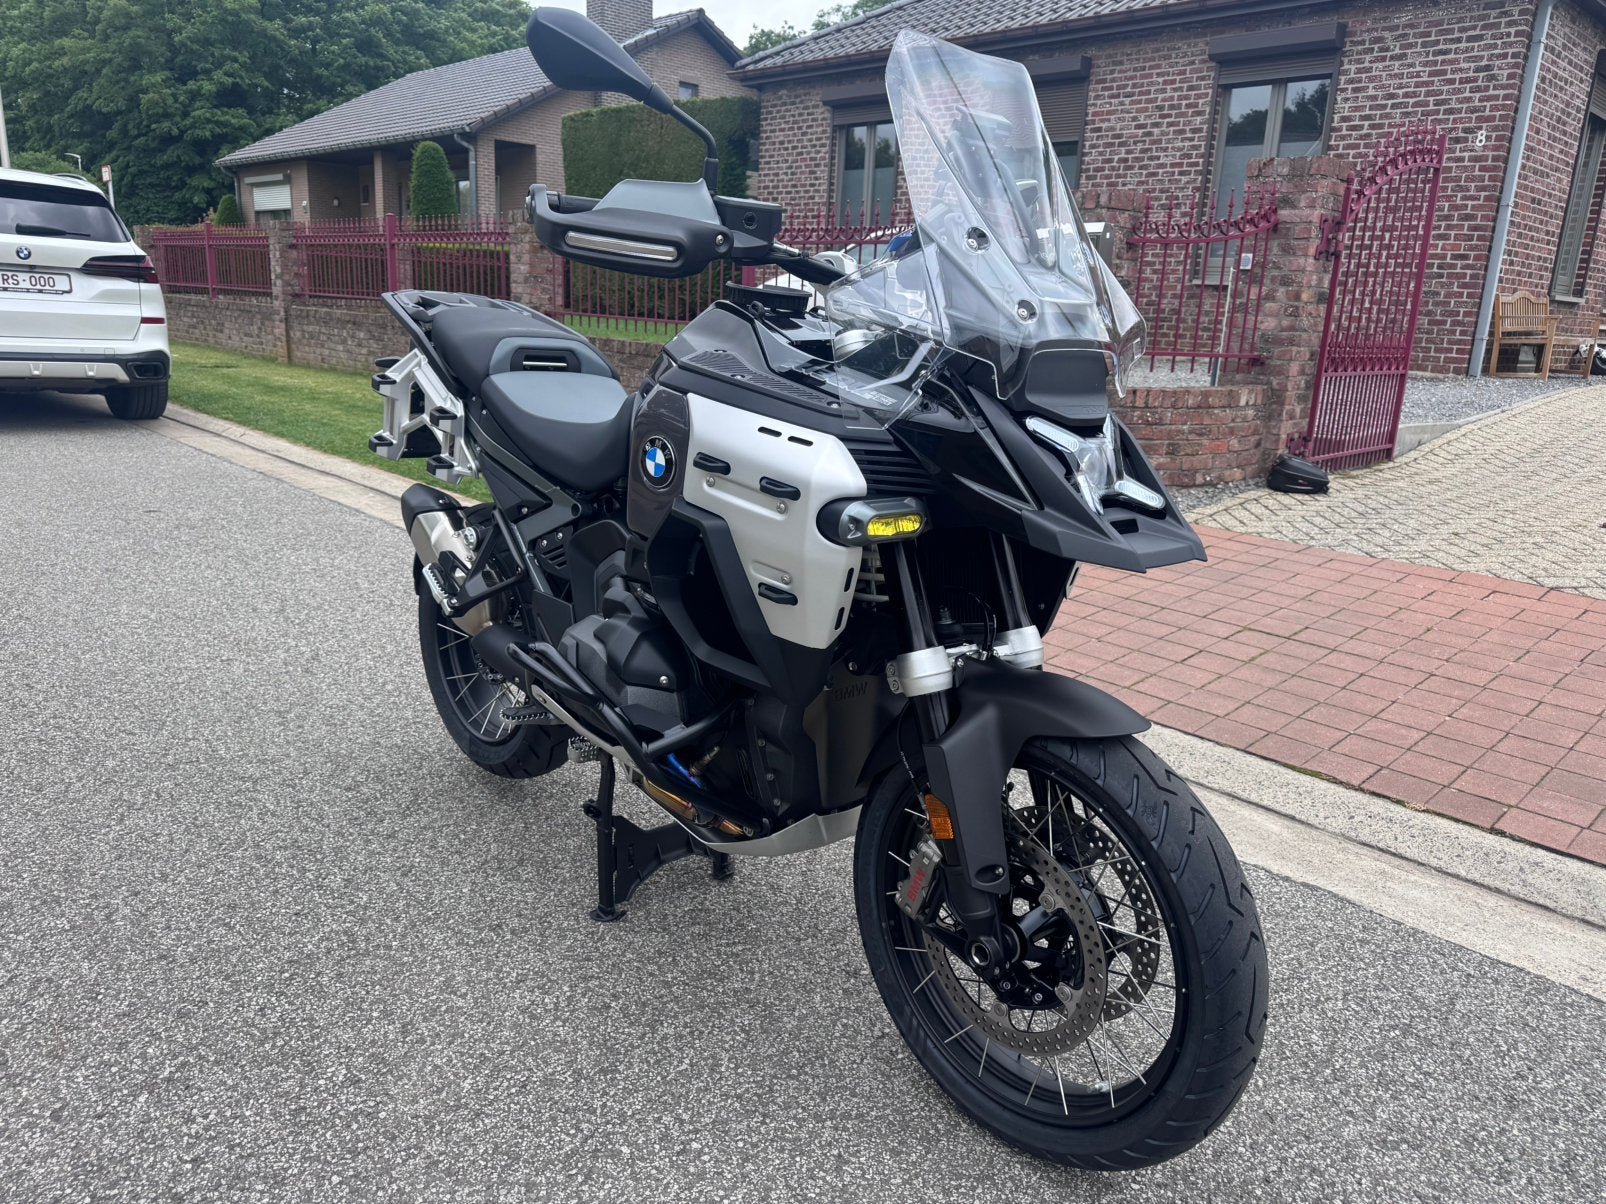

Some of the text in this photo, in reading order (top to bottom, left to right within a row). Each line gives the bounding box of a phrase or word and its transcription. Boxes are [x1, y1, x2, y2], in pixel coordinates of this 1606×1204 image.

[1476, 130, 1487, 147] 8
[645, 439, 671, 459] BMW
[833, 682, 868, 701] BMW
[907, 867, 926, 902] BMW
